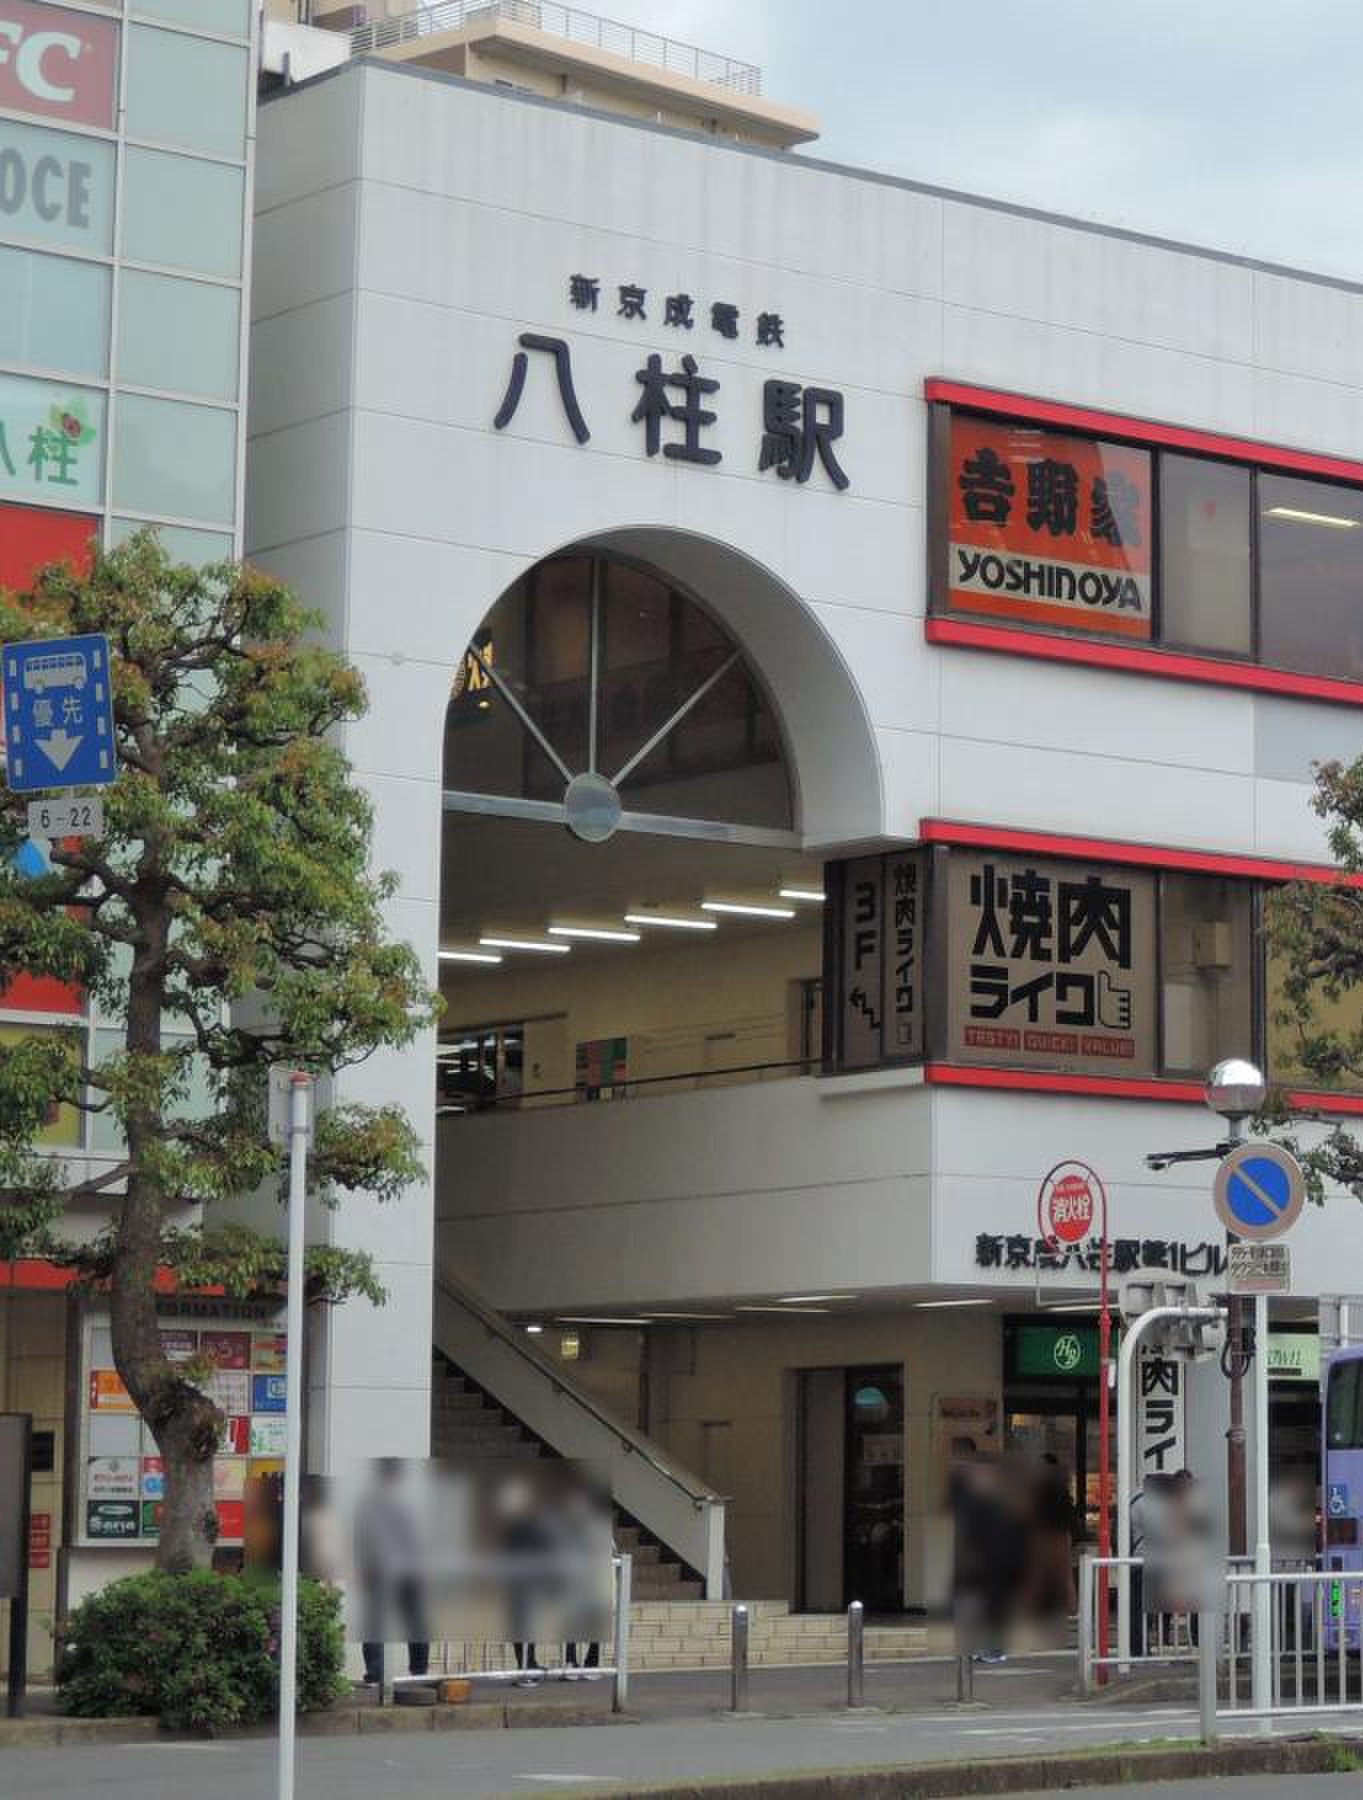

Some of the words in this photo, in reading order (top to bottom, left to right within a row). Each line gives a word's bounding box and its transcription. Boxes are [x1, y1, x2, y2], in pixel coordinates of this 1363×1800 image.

[569, 273, 784, 348] 新京成電鉄
[494, 332, 850, 491] 八柱駅
[959, 447, 1142, 548] 吉野家
[957, 550, 1142, 612] YOSHINOYA
[32, 696, 84, 728] 優先
[971, 864, 1131, 969] 焼肉
[971, 964, 1095, 1027] ライク
[1053, 1198, 1090, 1223] 消火栓
